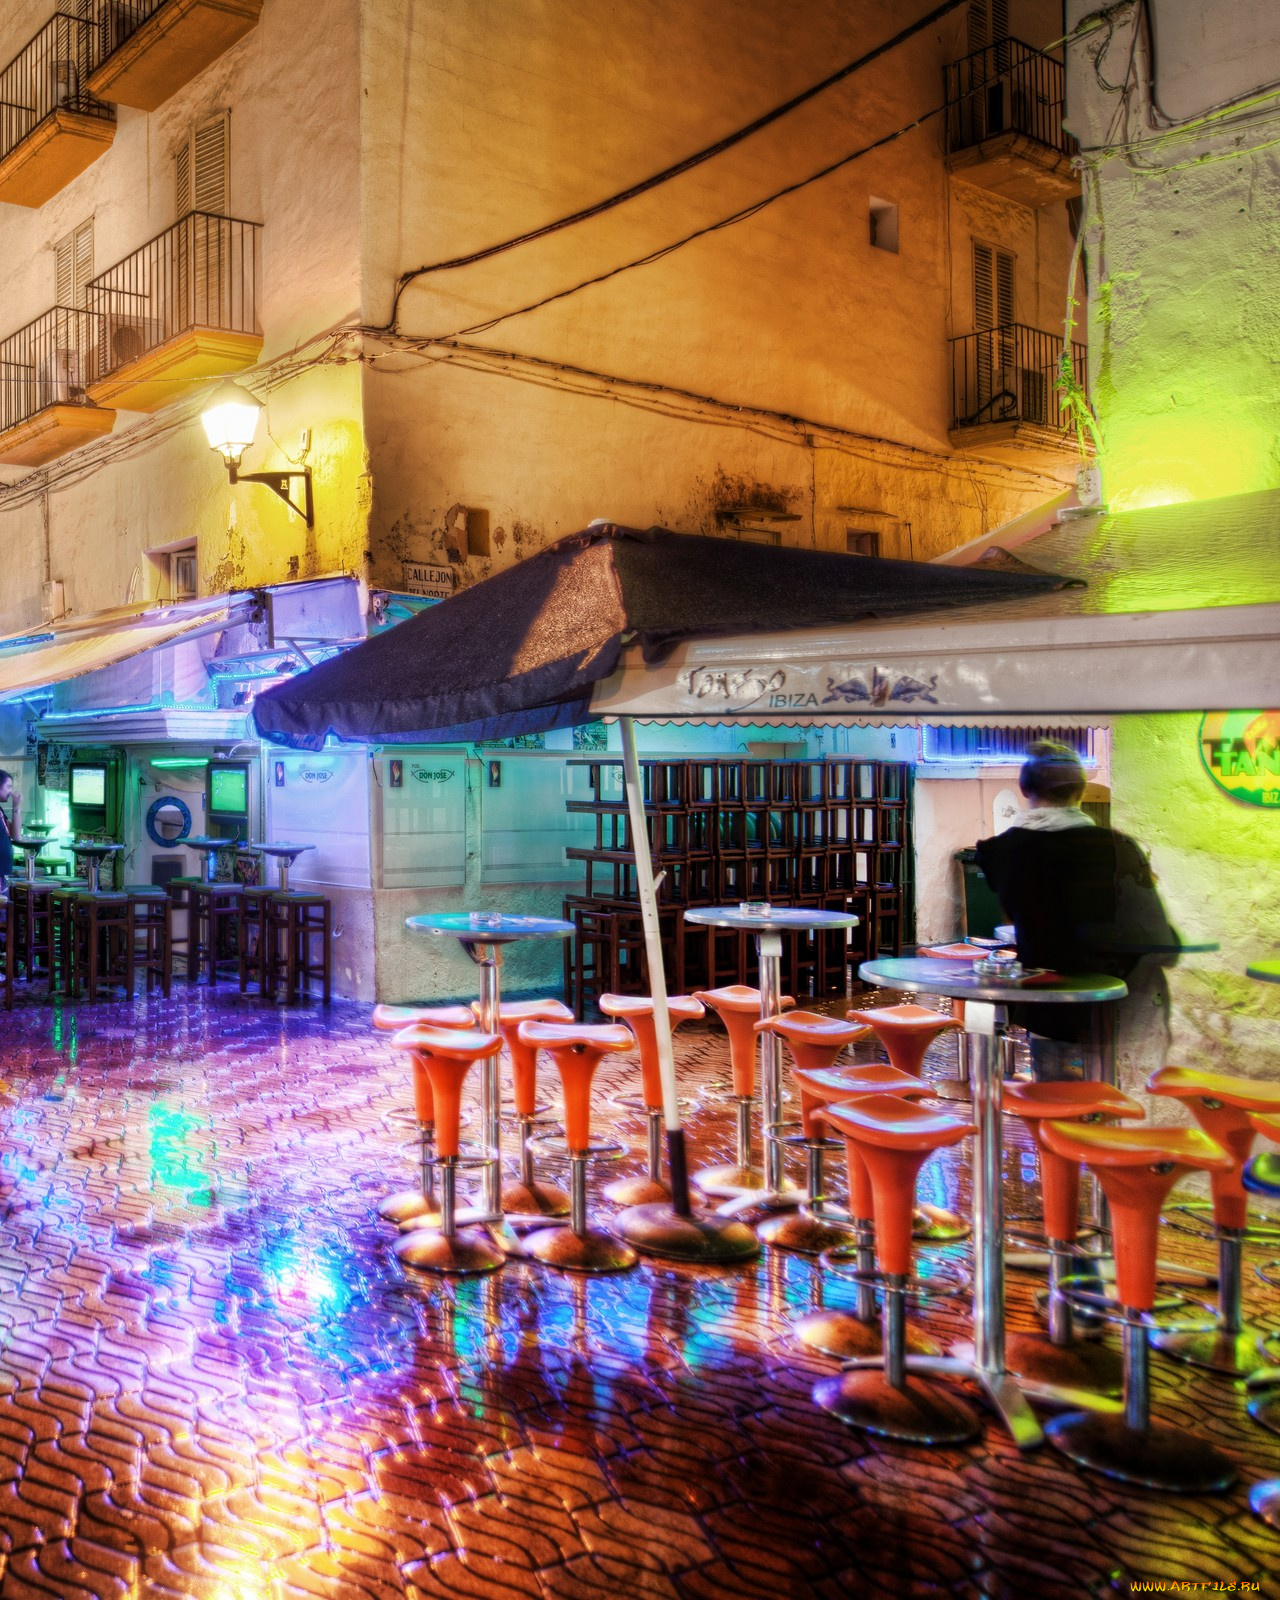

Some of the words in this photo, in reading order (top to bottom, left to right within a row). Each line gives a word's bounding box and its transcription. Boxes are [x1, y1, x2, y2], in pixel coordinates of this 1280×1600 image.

[769, 693, 819, 708] IBIZA
[305, 772, 316, 780] DON
[316, 772, 328, 781] JOSE
[418, 772, 432, 780] DON
[433, 772, 447, 781] JOSE
